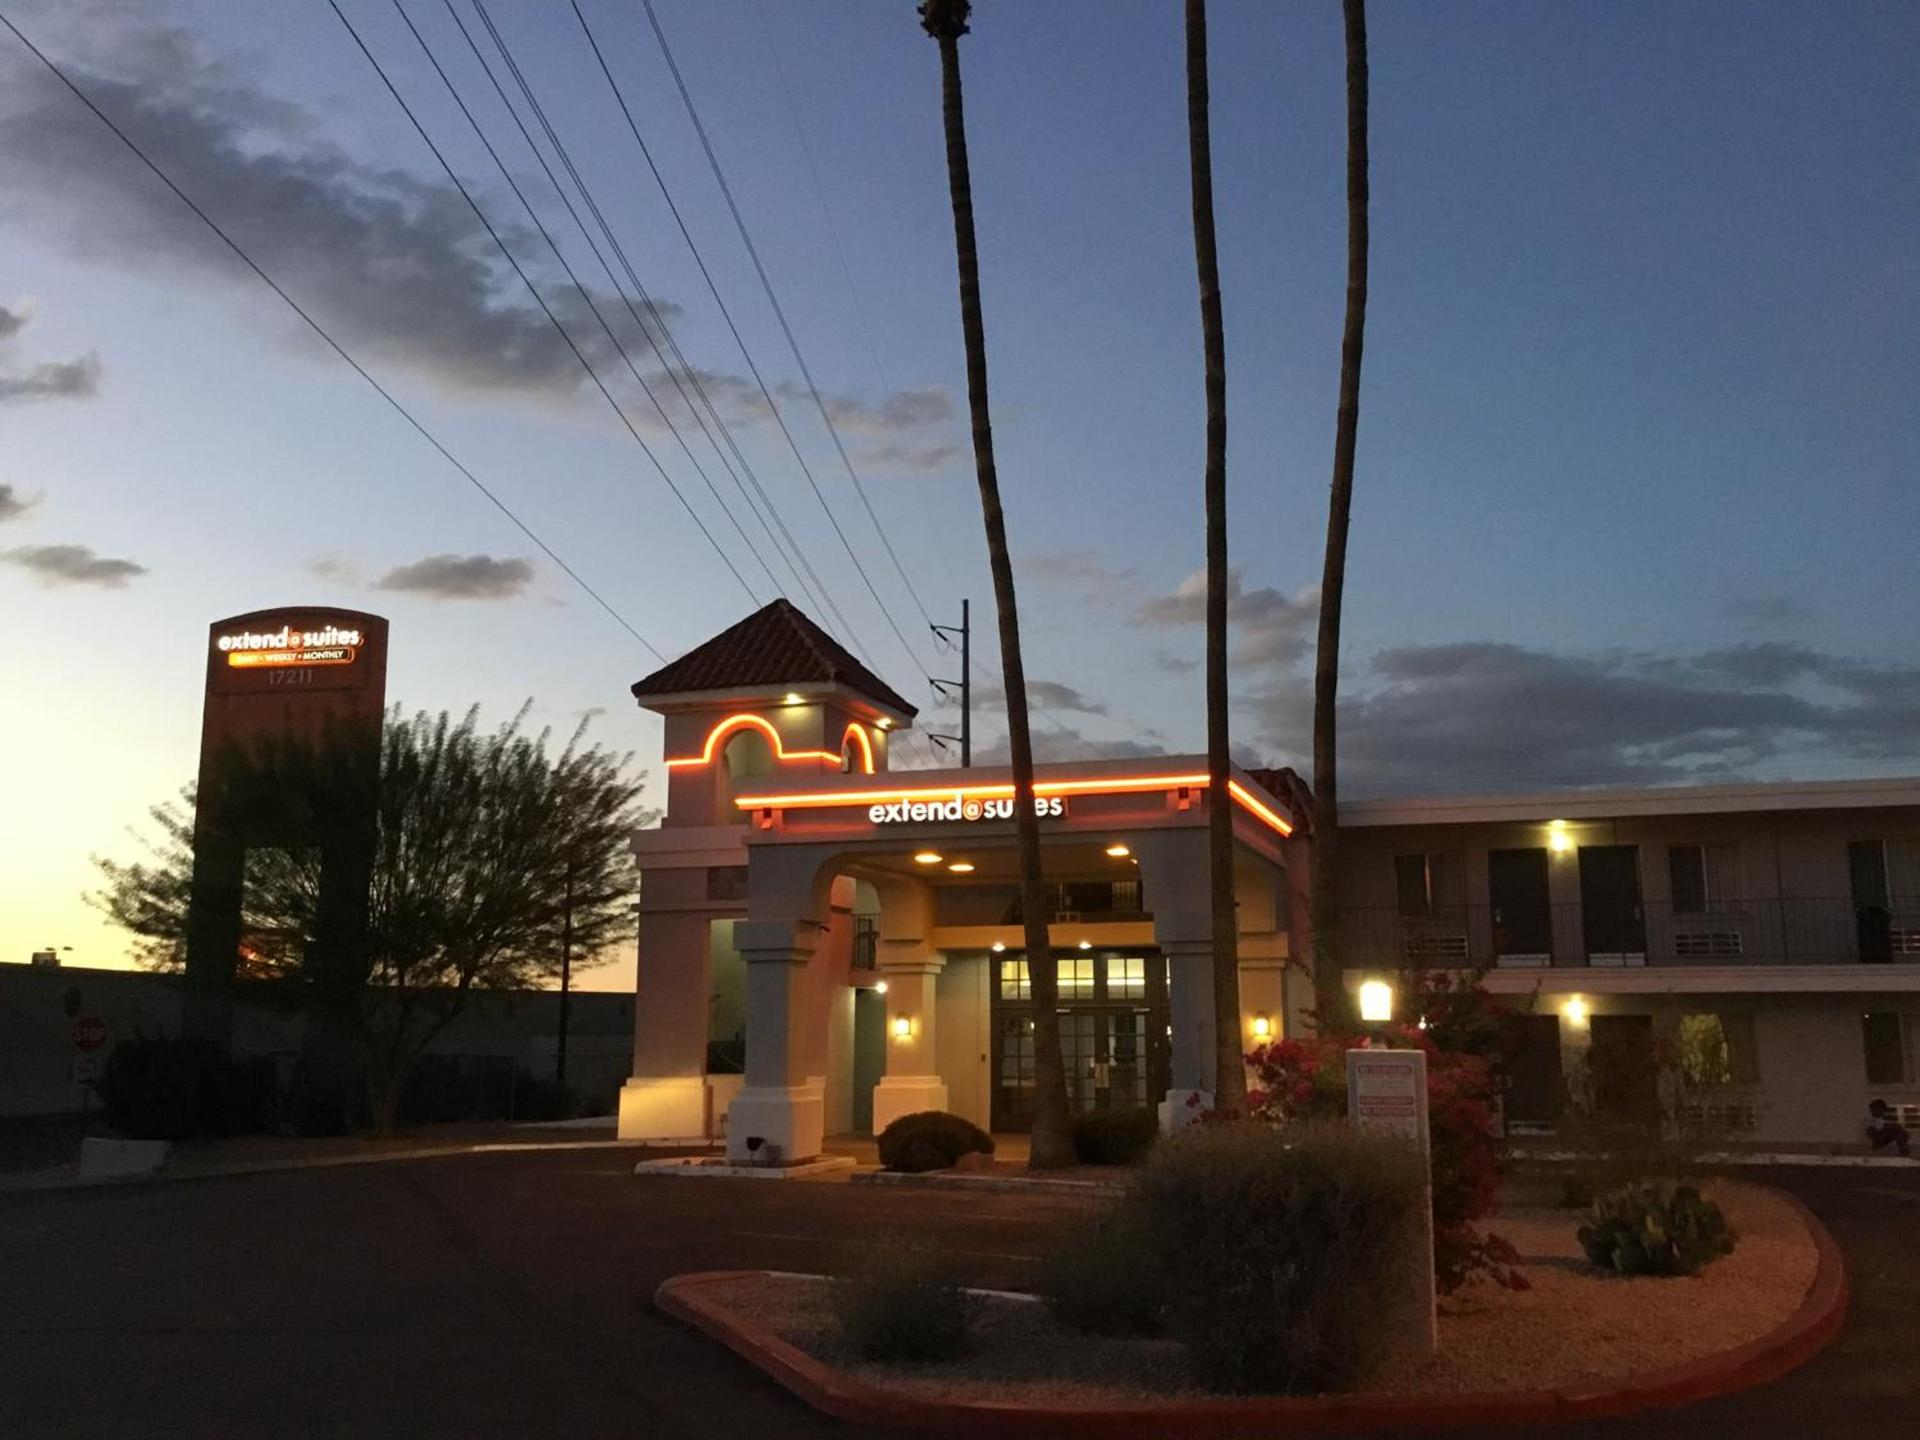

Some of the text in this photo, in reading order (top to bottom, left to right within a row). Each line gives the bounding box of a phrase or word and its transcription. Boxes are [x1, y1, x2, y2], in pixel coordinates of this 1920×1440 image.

[302, 650, 344, 660] MONTHLY
[269, 668, 312, 685] 17211
[868, 791, 962, 822] extend
[983, 796, 1063, 819] sues
[75, 1026, 105, 1041] STOP
